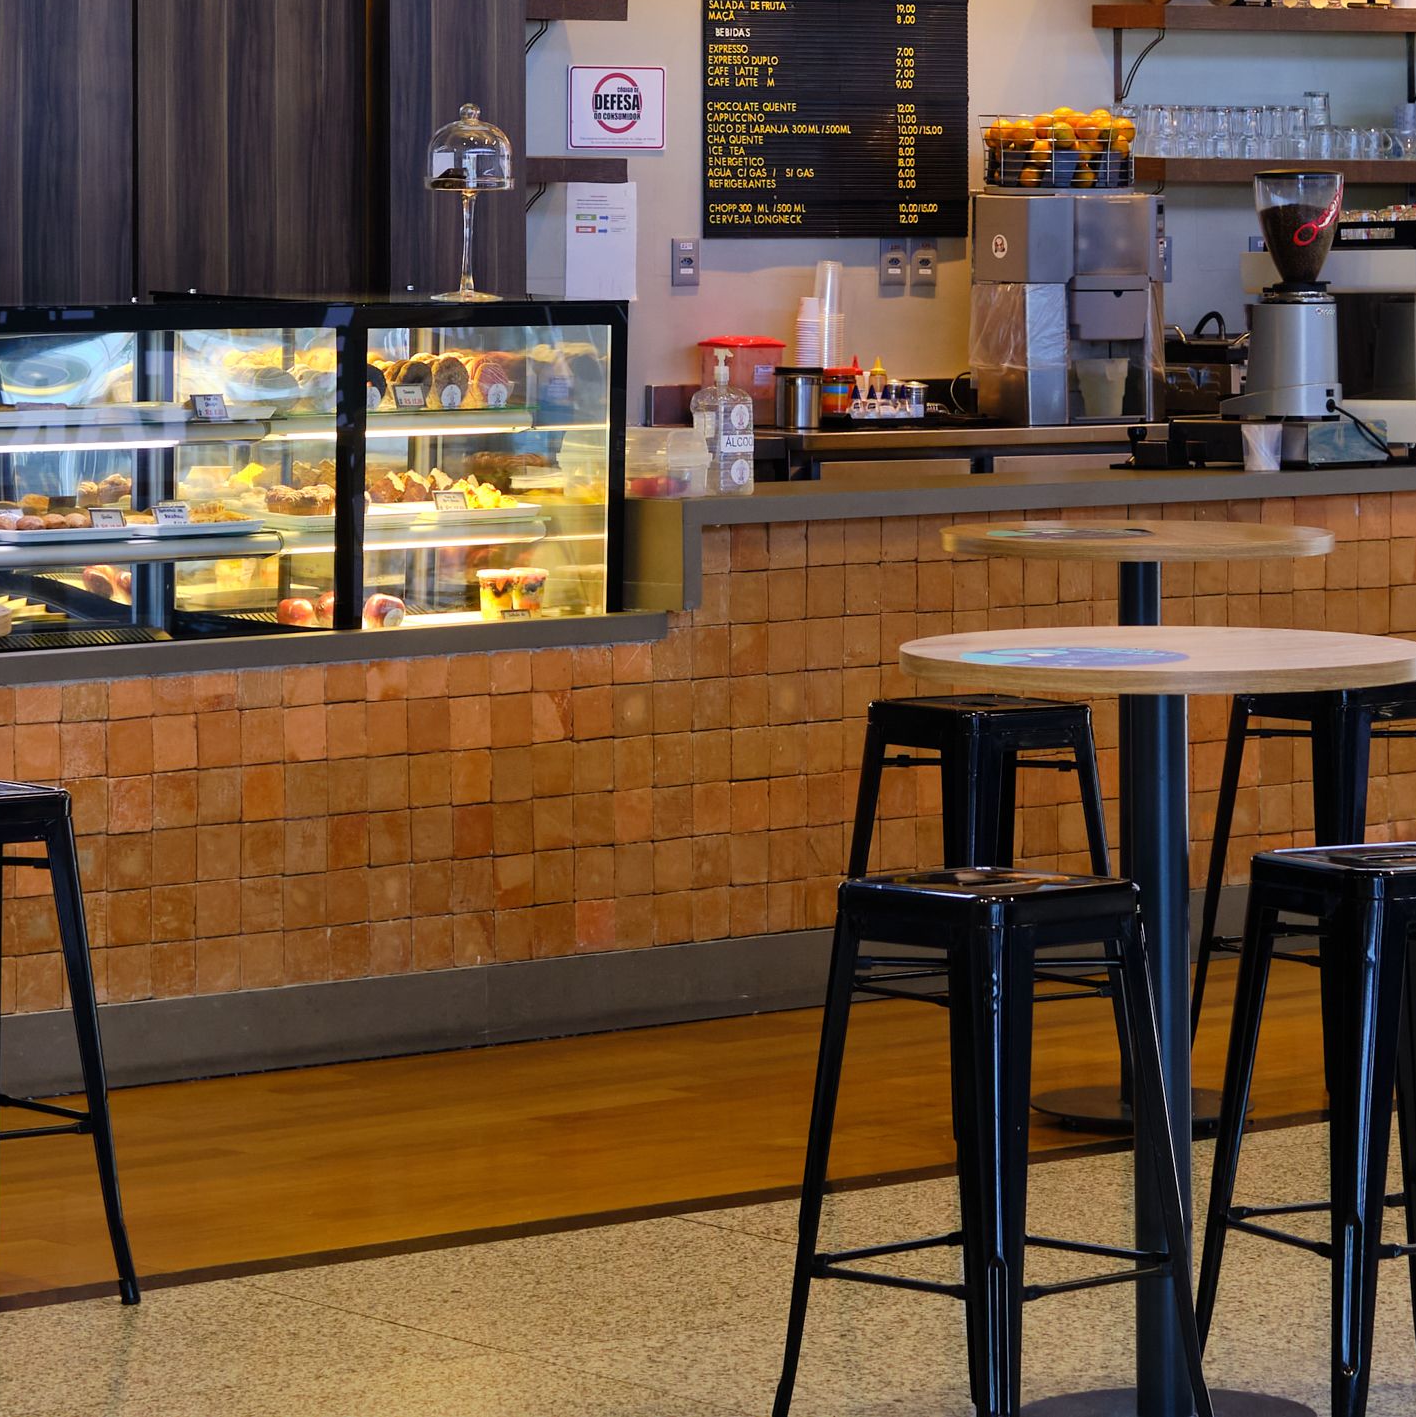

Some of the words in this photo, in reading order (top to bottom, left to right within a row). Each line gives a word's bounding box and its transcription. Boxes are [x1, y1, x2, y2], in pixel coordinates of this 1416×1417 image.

[709, 0, 745, 9] SALADA
[751, 1, 760, 10] DE
[762, 2, 786, 10] FRUTA
[897, 5, 915, 13] 19.00
[716, 28, 750, 37] BEBIDAS
[709, 45, 748, 53] EXPRESSO
[897, 48, 914, 56] 7.00
[709, 56, 749, 64] EXPRESSO
[752, 56, 778, 65] DUPLO
[896, 58, 914, 67] 9.00
[708, 67, 728, 75] CAFE
[735, 67, 758, 75] LATTE
[896, 69, 914, 78] 7.00
[708, 78, 729, 86] CAFE
[736, 78, 757, 86] LATTE
[767, 78, 774, 86] M
[896, 80, 912, 88] 9.00
[594, 94, 640, 110] DEFESA
[707, 102, 758, 111] CHOCOLATE
[763, 103, 796, 111] QUENTE
[897, 104, 914, 113] 12.00
[603, 112, 640, 120] CONSUMIDOR
[707, 113, 764, 122] CAPPUCCINO
[897, 115, 916, 123] 11.00
[708, 124, 733, 132] SUCO
[736, 124, 746, 133] DE
[750, 125, 789, 133] LARANJA
[729, 135, 763, 144] QUENTE
[899, 136, 914, 145] 7.00
[709, 146, 722, 155] ICE
[730, 147, 745, 155] TEA
[899, 148, 914, 156] 8.00
[709, 157, 764, 166] ENERGETICO
[708, 168, 731, 176] AGUA
[749, 168, 766, 177] GAS
[797, 169, 814, 177] GAS
[898, 169, 915, 177] 6.00
[710, 179, 776, 188] REFRIGERANTES
[899, 180, 916, 188] 8.00
[710, 204, 737, 212] CHOPP
[710, 215, 751, 223] CERVEJA
[754, 215, 801, 223] LONGNECK
[900, 215, 918, 223] 12.00
